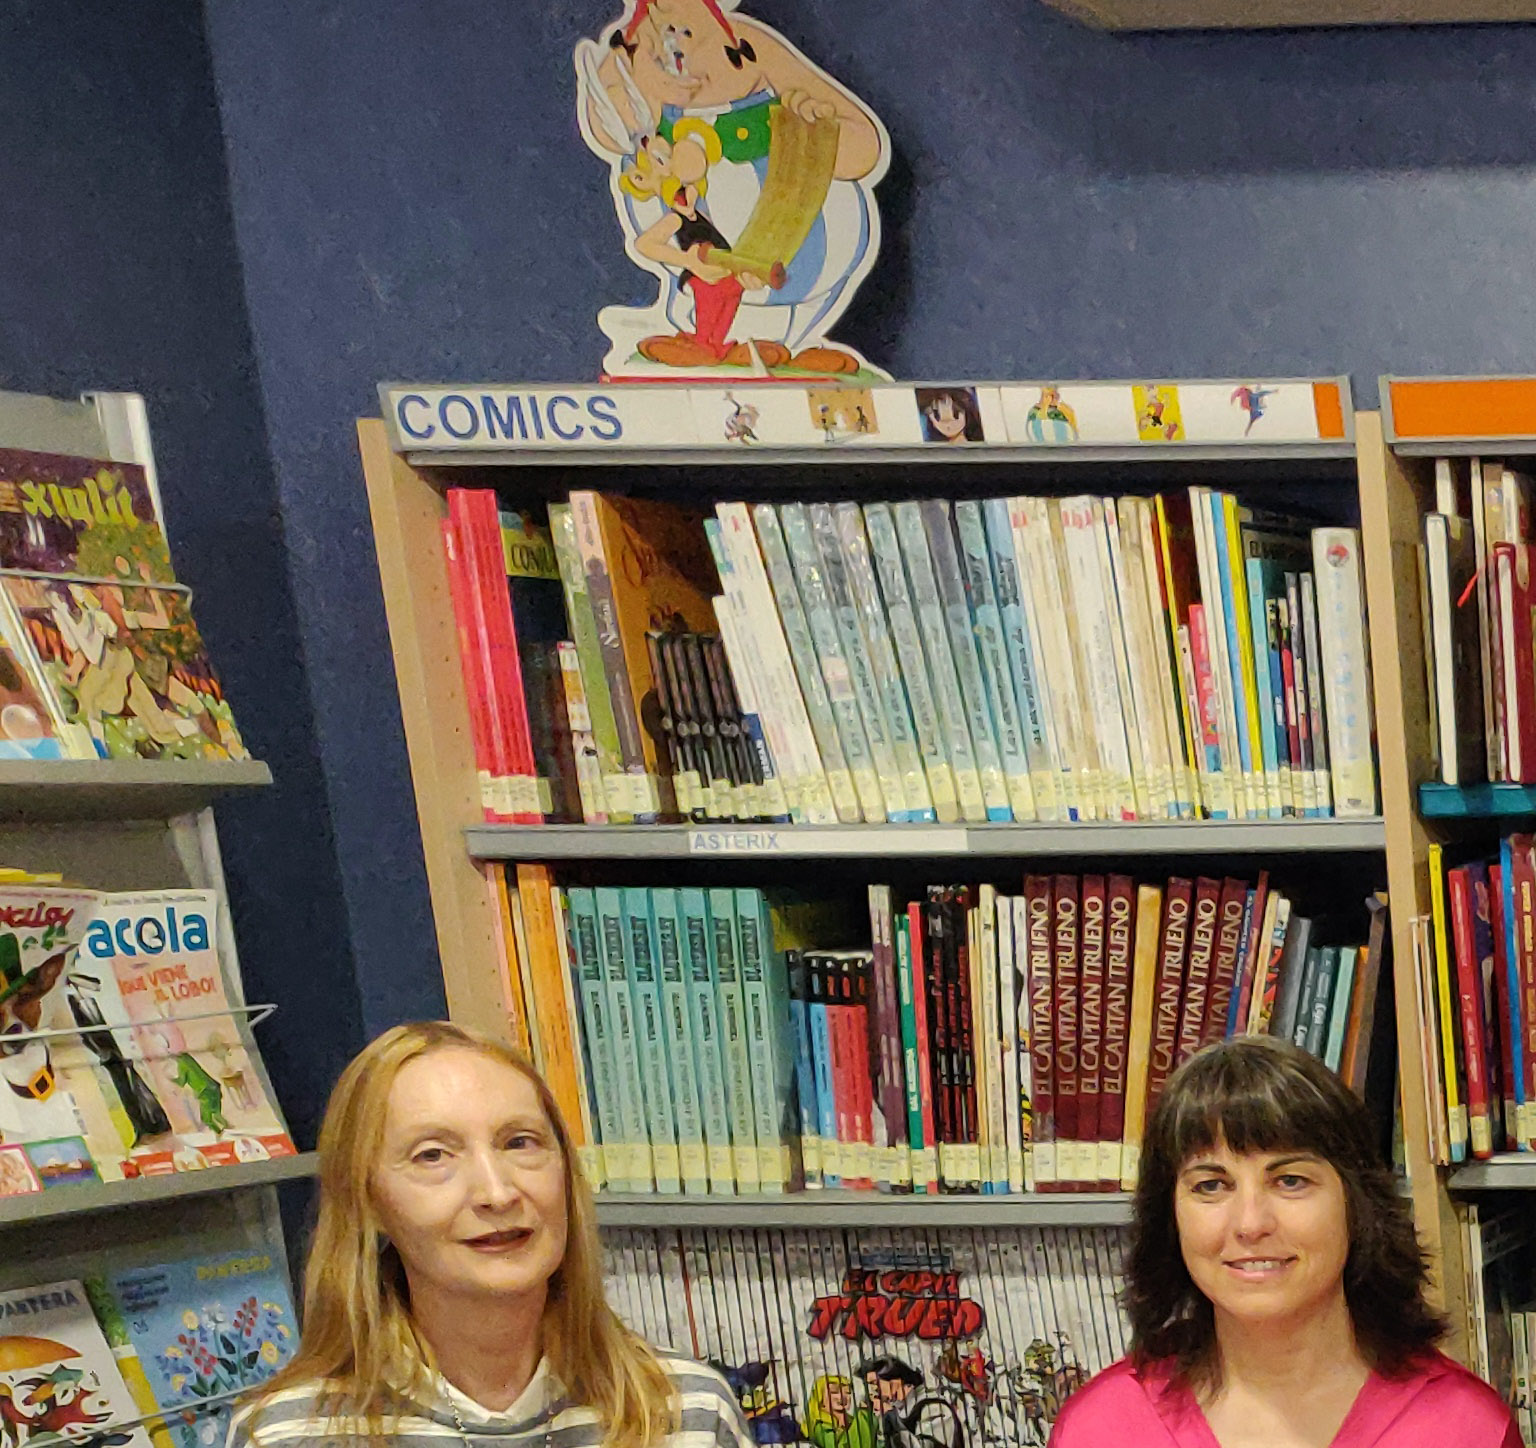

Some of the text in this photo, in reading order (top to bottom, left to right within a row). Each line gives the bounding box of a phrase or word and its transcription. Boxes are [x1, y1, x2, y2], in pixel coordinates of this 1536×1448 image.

[397, 393, 624, 441] COMICS
[692, 832, 781, 851] ASTERIX
[1030, 897, 1050, 979] TRUENO
[1056, 897, 1078, 979] TRUENO
[1083, 896, 1104, 978] TRUENO
[1108, 896, 1130, 978] TRUENO
[1162, 897, 1189, 979] TRUENO
[1188, 898, 1217, 979] TRUENO
